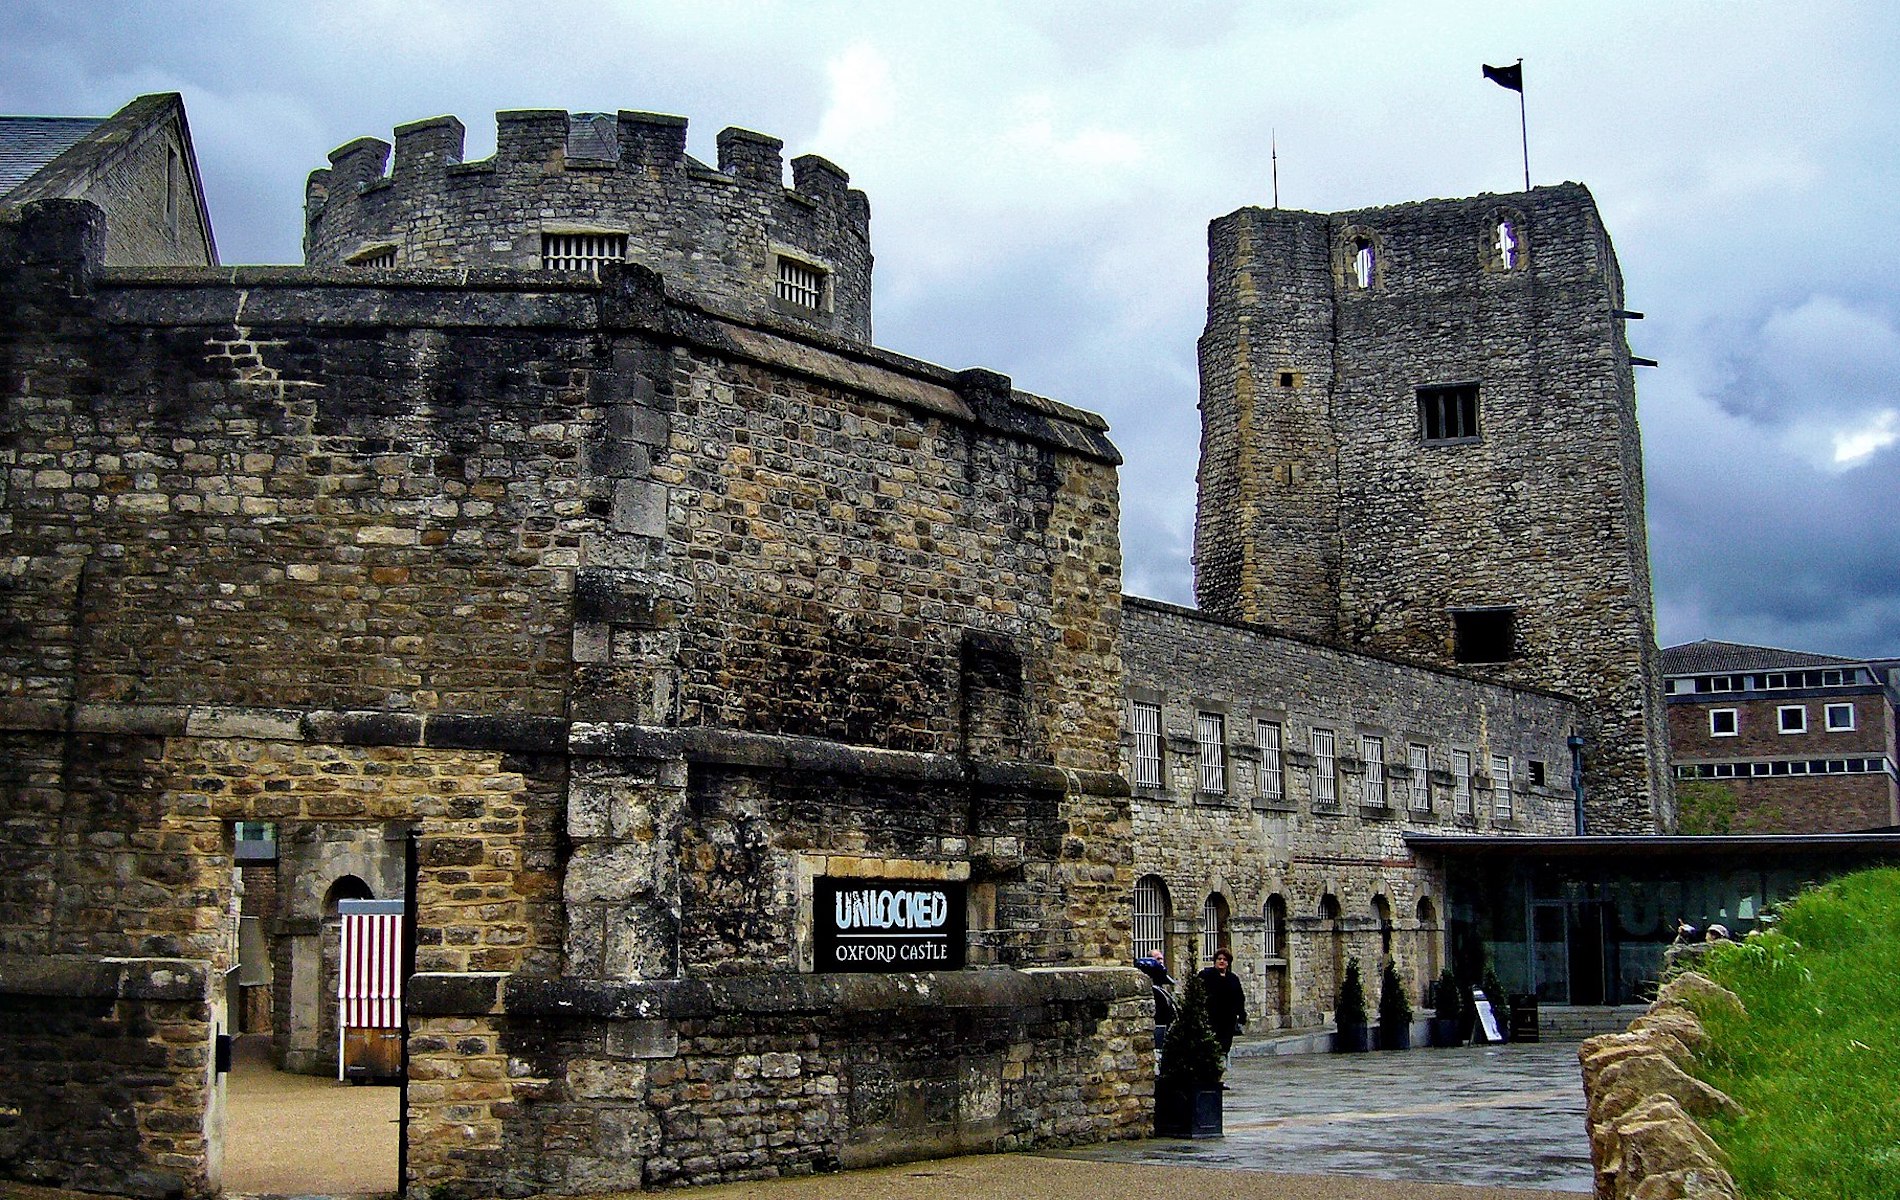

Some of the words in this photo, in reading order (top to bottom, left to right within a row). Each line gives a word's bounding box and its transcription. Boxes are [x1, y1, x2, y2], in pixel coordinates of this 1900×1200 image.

[836, 890, 947, 929] UNLOCKED
[836, 945, 896, 963] OXFORD
[900, 941, 947, 960] CASTLE
